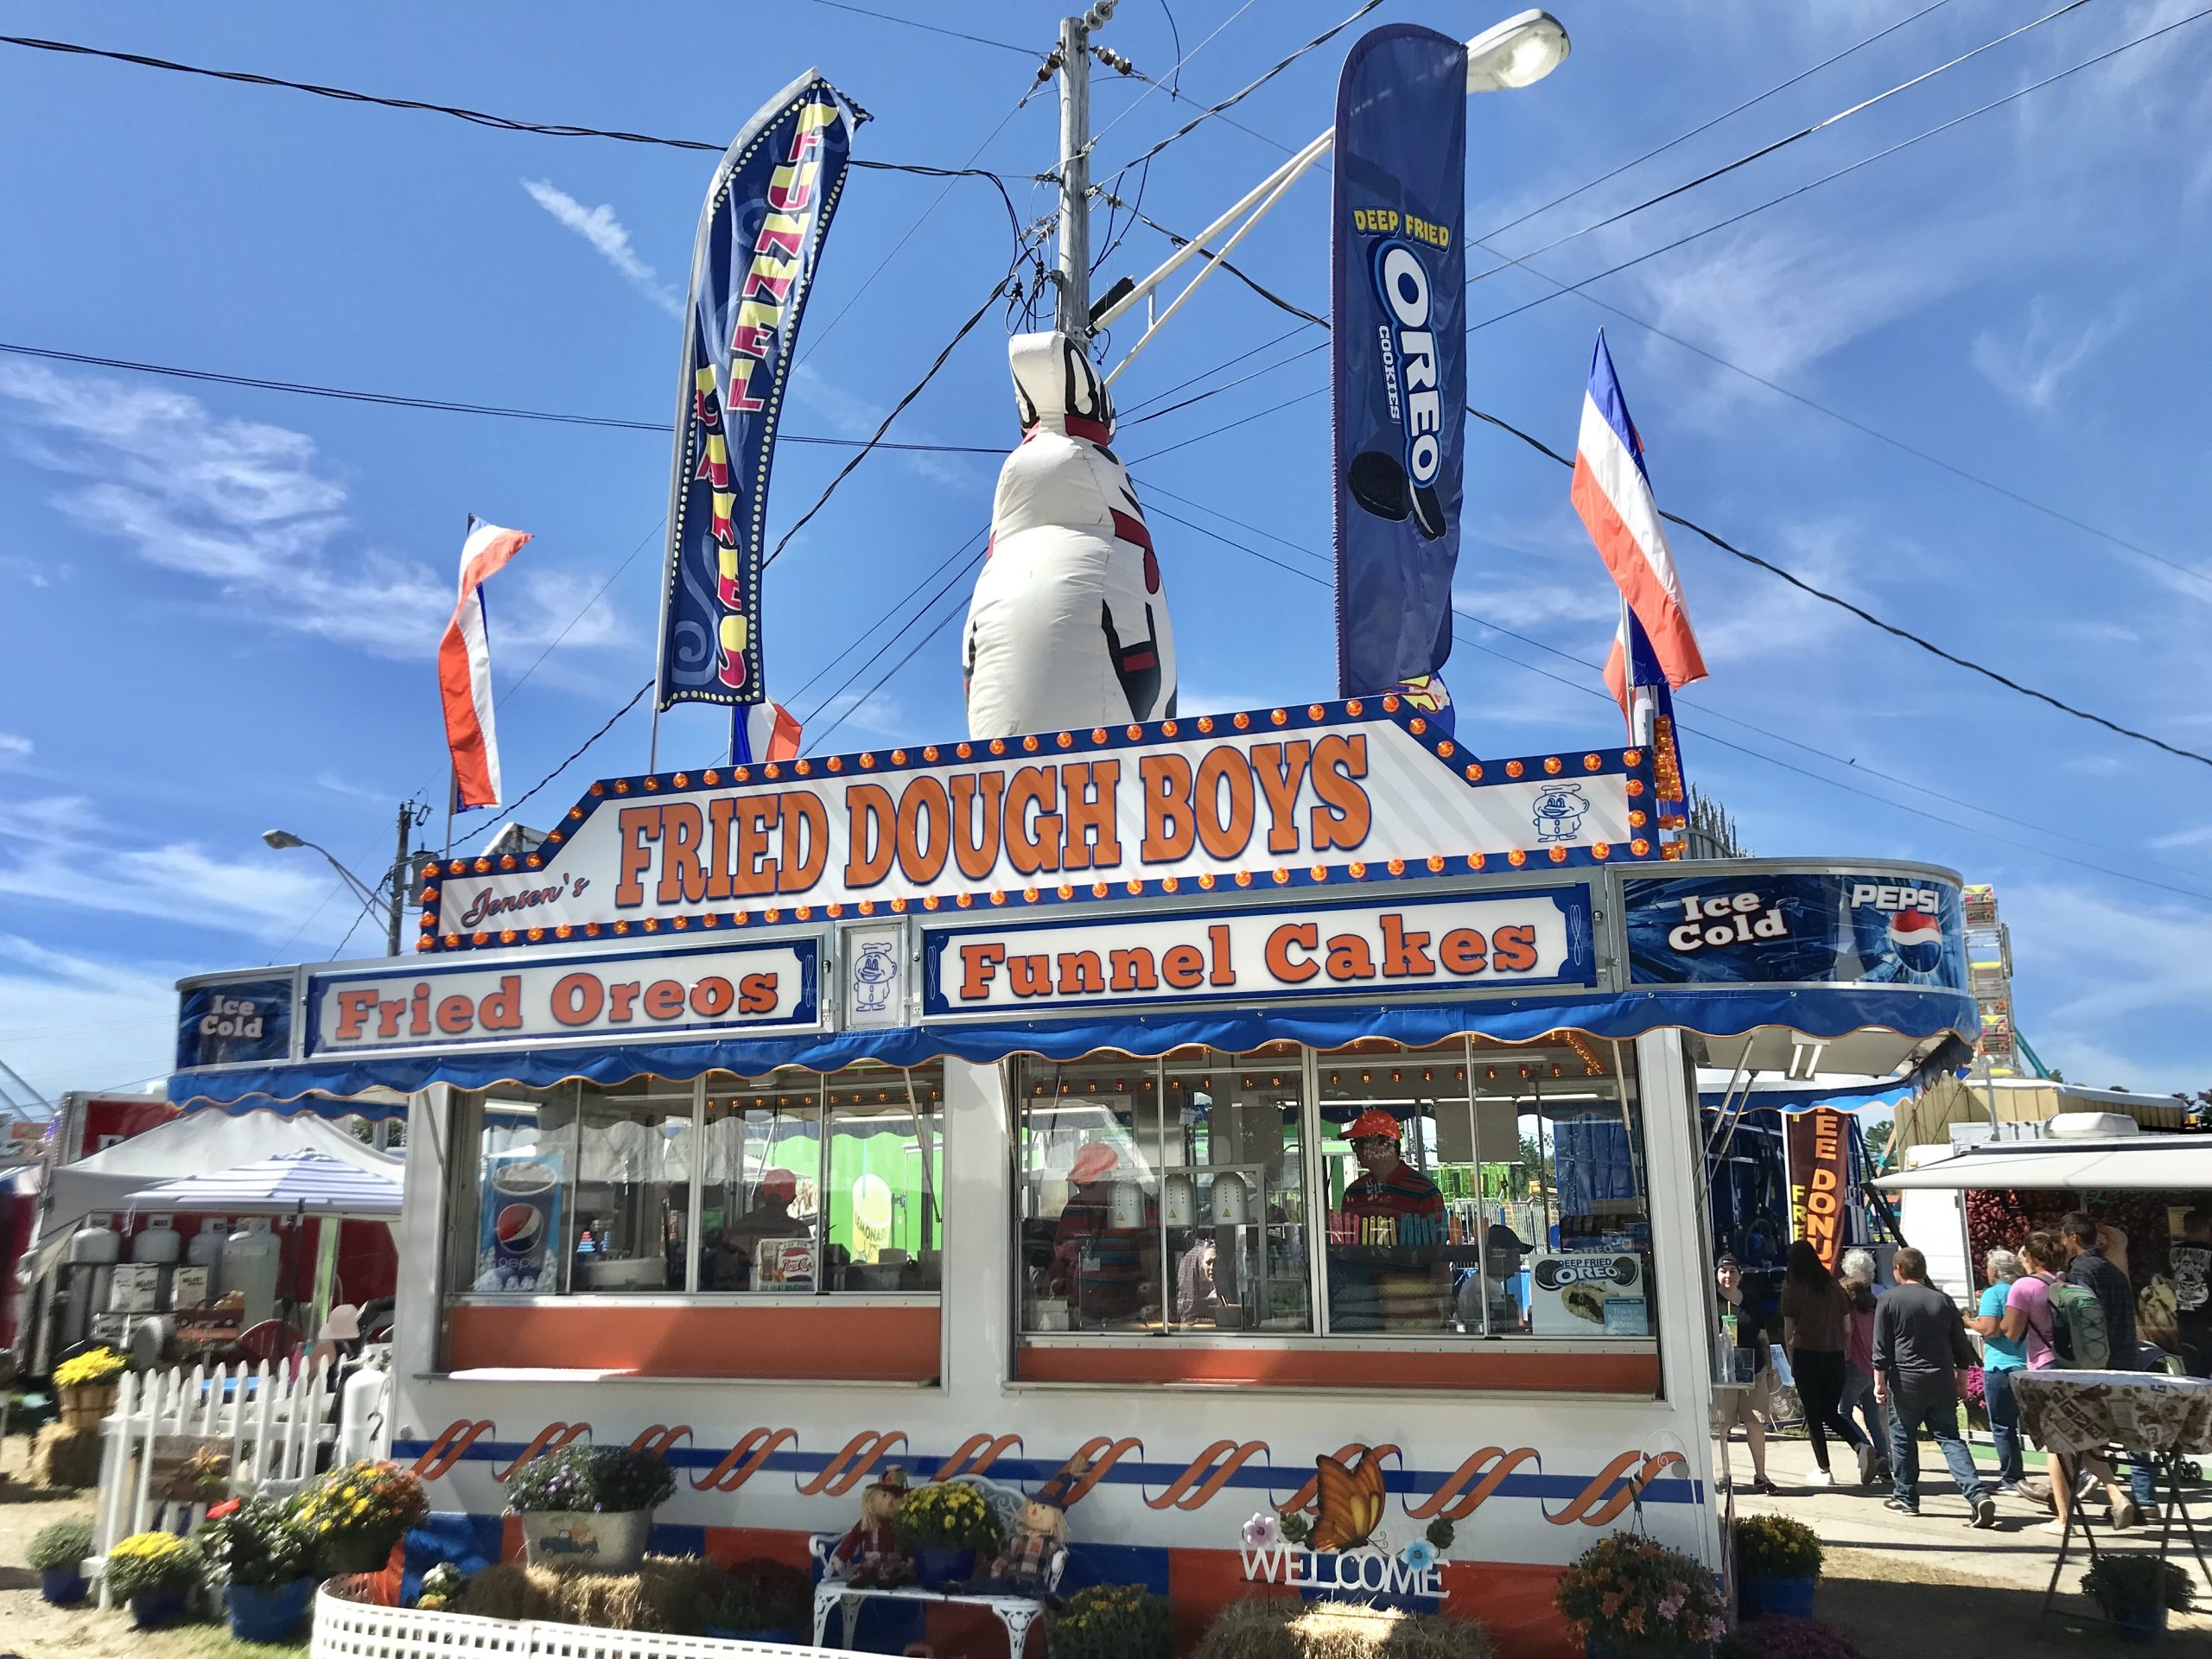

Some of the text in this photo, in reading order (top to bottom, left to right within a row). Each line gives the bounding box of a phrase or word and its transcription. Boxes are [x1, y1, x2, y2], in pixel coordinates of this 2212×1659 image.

[1352, 208, 1451, 248] DEEP FRIED
[725, 101, 839, 413] FUNNEL
[1378, 323, 1400, 421] COOKIES
[1383, 247, 1441, 482] OREO
[614, 733, 1372, 909] FRIED DOUGH BOYS
[461, 871, 589, 929] Jensen's
[1681, 892, 1761, 924] Ice
[1851, 884, 1940, 915] PEPSI
[1668, 909, 1788, 952] Cold
[959, 912, 1538, 1000] Funnel Cakes
[199, 1014, 263, 1039] Cold
[211, 994, 255, 1017] Ice
[335, 971, 779, 1040] Fried Oreos
[1807, 1108, 1838, 1272] EE DONU
[499, 1256, 541, 1270] pepsi
[1554, 1266, 1619, 1284] OREO
[1584, 1258, 1611, 1268] FRIED
[1239, 1541, 1451, 1599] WELCOME
